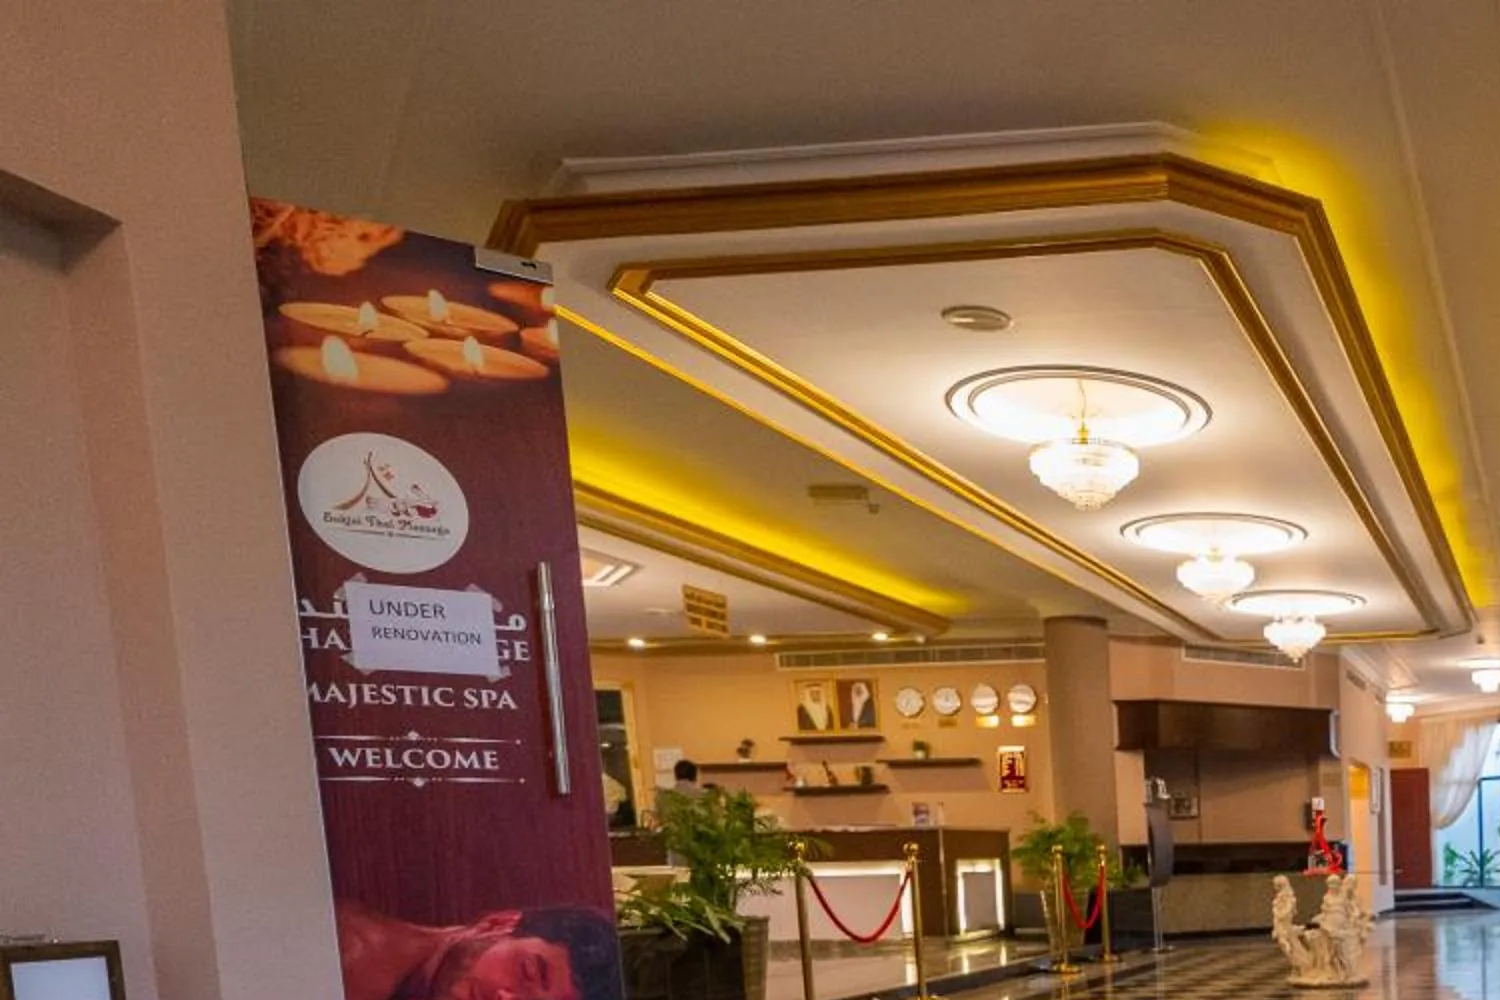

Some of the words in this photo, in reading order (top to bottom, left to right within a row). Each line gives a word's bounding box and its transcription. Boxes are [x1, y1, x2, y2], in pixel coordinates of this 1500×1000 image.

[369, 600, 446, 621] UNDER
[371, 627, 481, 645] RENOVATION
[463, 687, 518, 710] SPA
[328, 747, 499, 770] WELCOME
